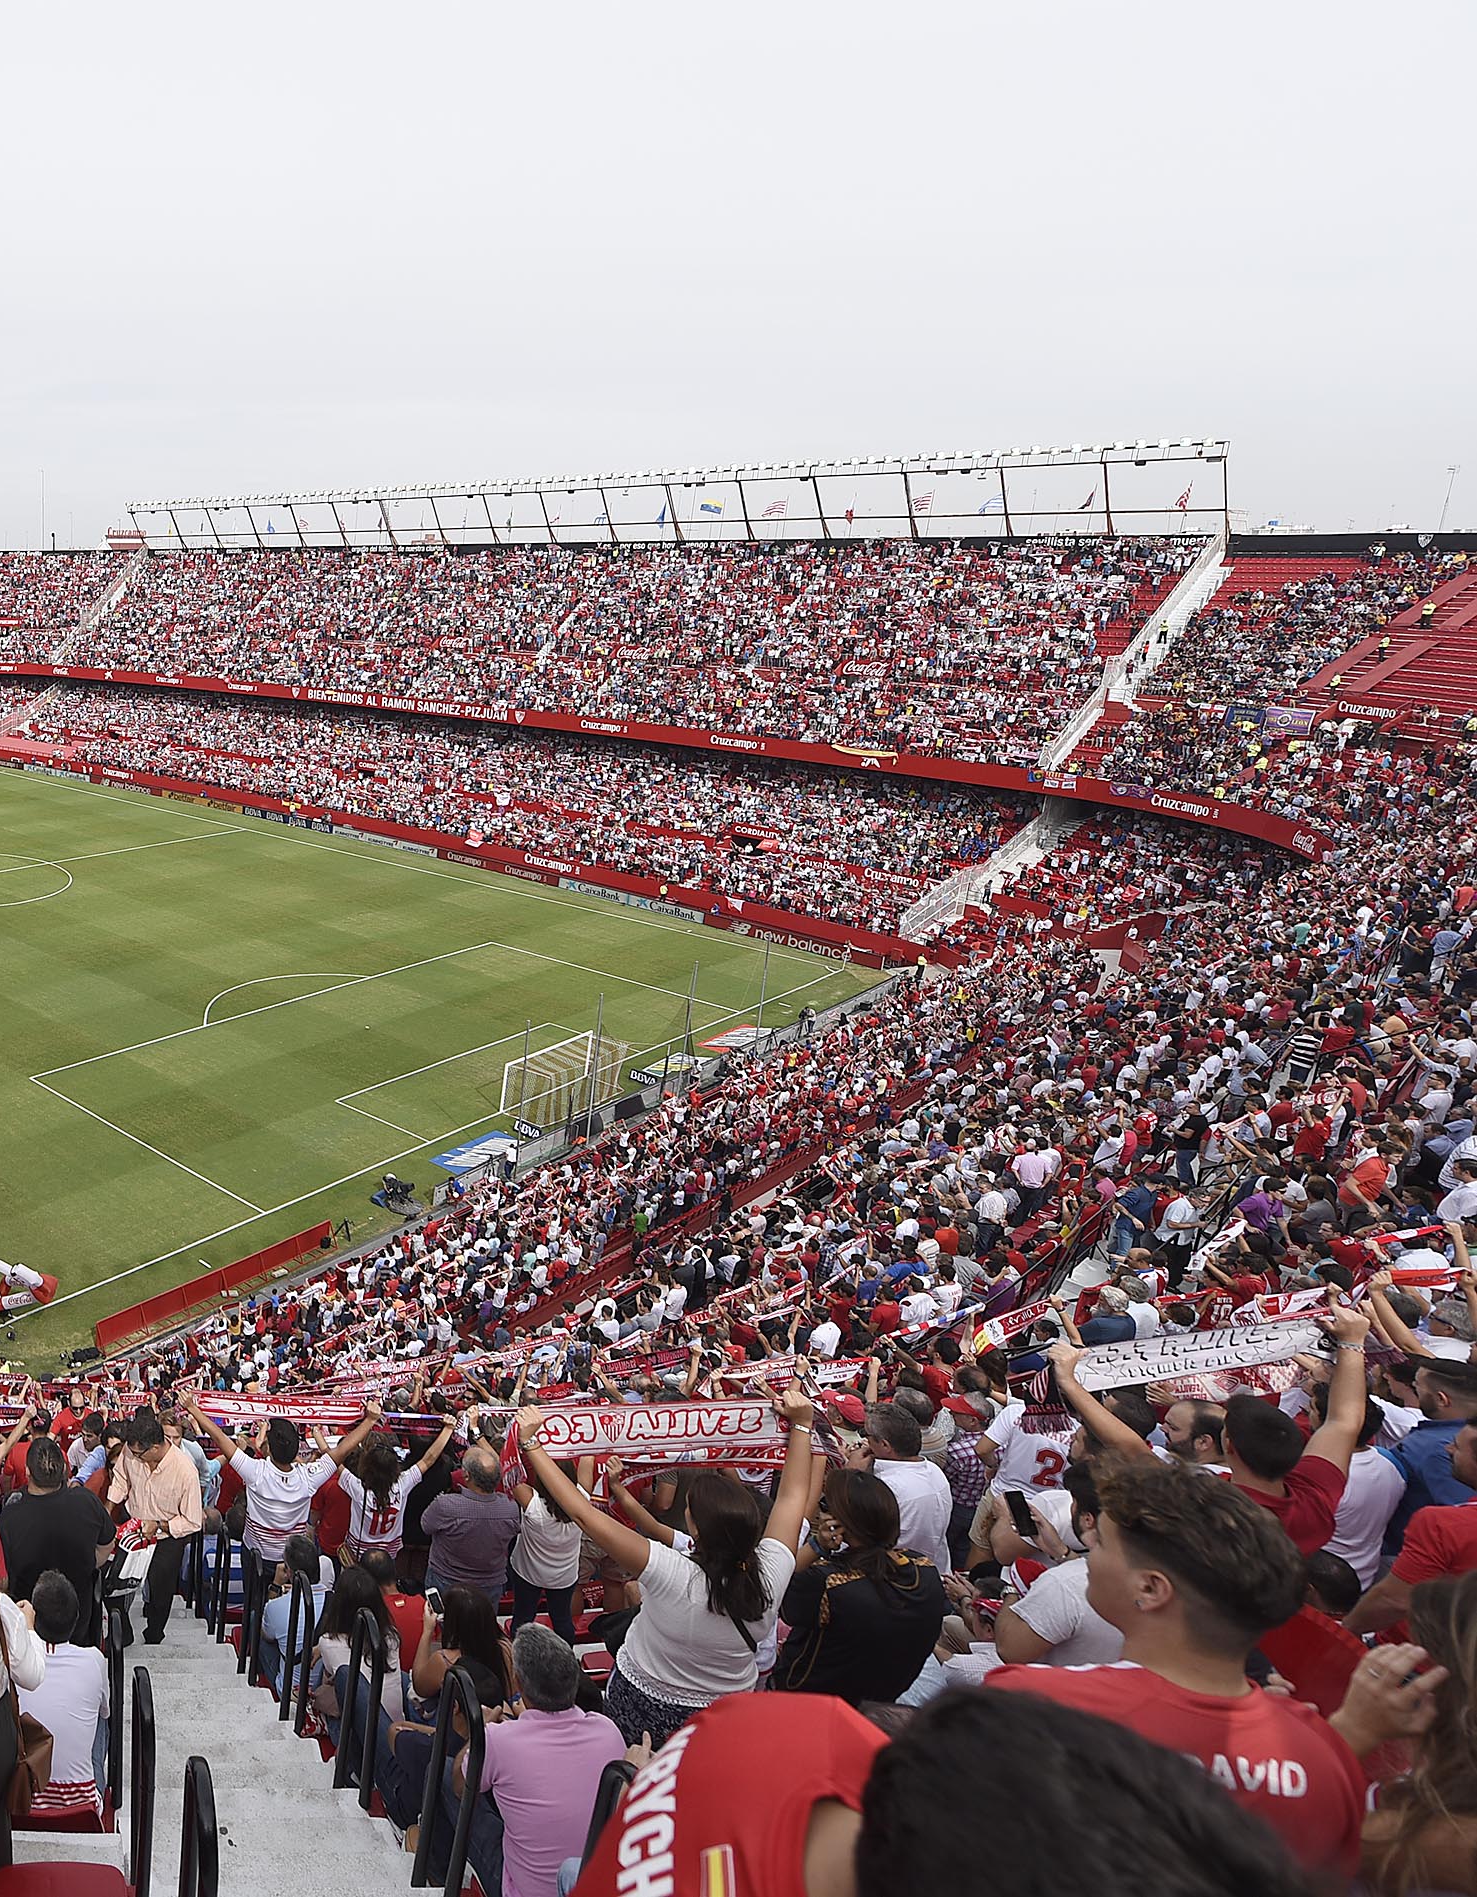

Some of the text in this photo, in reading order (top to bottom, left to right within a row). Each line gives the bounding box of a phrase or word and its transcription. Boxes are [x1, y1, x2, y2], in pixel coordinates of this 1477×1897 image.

[108, 526, 147, 539] Cruzcampo
[1025, 536, 1077, 548] sevillista
[842, 659, 891, 677] Coca-Cola
[366, 695, 379, 706] AL
[1338, 700, 1398, 719] Cruzcampo
[580, 719, 622, 734] Cruzcampo
[709, 734, 760, 751] Cruzcampo
[102, 768, 130, 779] Cruzcampo
[111, 780, 125, 789] new
[125, 782, 152, 794] balance
[1150, 793, 1212, 818] Cruzcampo
[266, 811, 284, 822] BBVA
[311, 820, 330, 833] BBVA
[733, 825, 780, 841] CORDIALITY
[1292, 829, 1317, 856] Coca-Cola
[447, 851, 482, 867] Cruzcampo
[524, 852, 573, 874] Cruzcampo
[504, 864, 542, 881] Cruzcampo
[577, 883, 621, 902] CaixaBank
[649, 901, 696, 921] CaixaBank
[754, 926, 786, 944] new
[787, 933, 853, 962] balance
[629, 1069, 657, 1087] BBVA
[513, 1119, 541, 1139] BBVA
[8, 1294, 32, 1306] Coca-Cola
[1031, 1448, 1067, 1488] 2
[368, 1506, 400, 1537] 16
[1191, 1753, 1308, 1798] AVID
